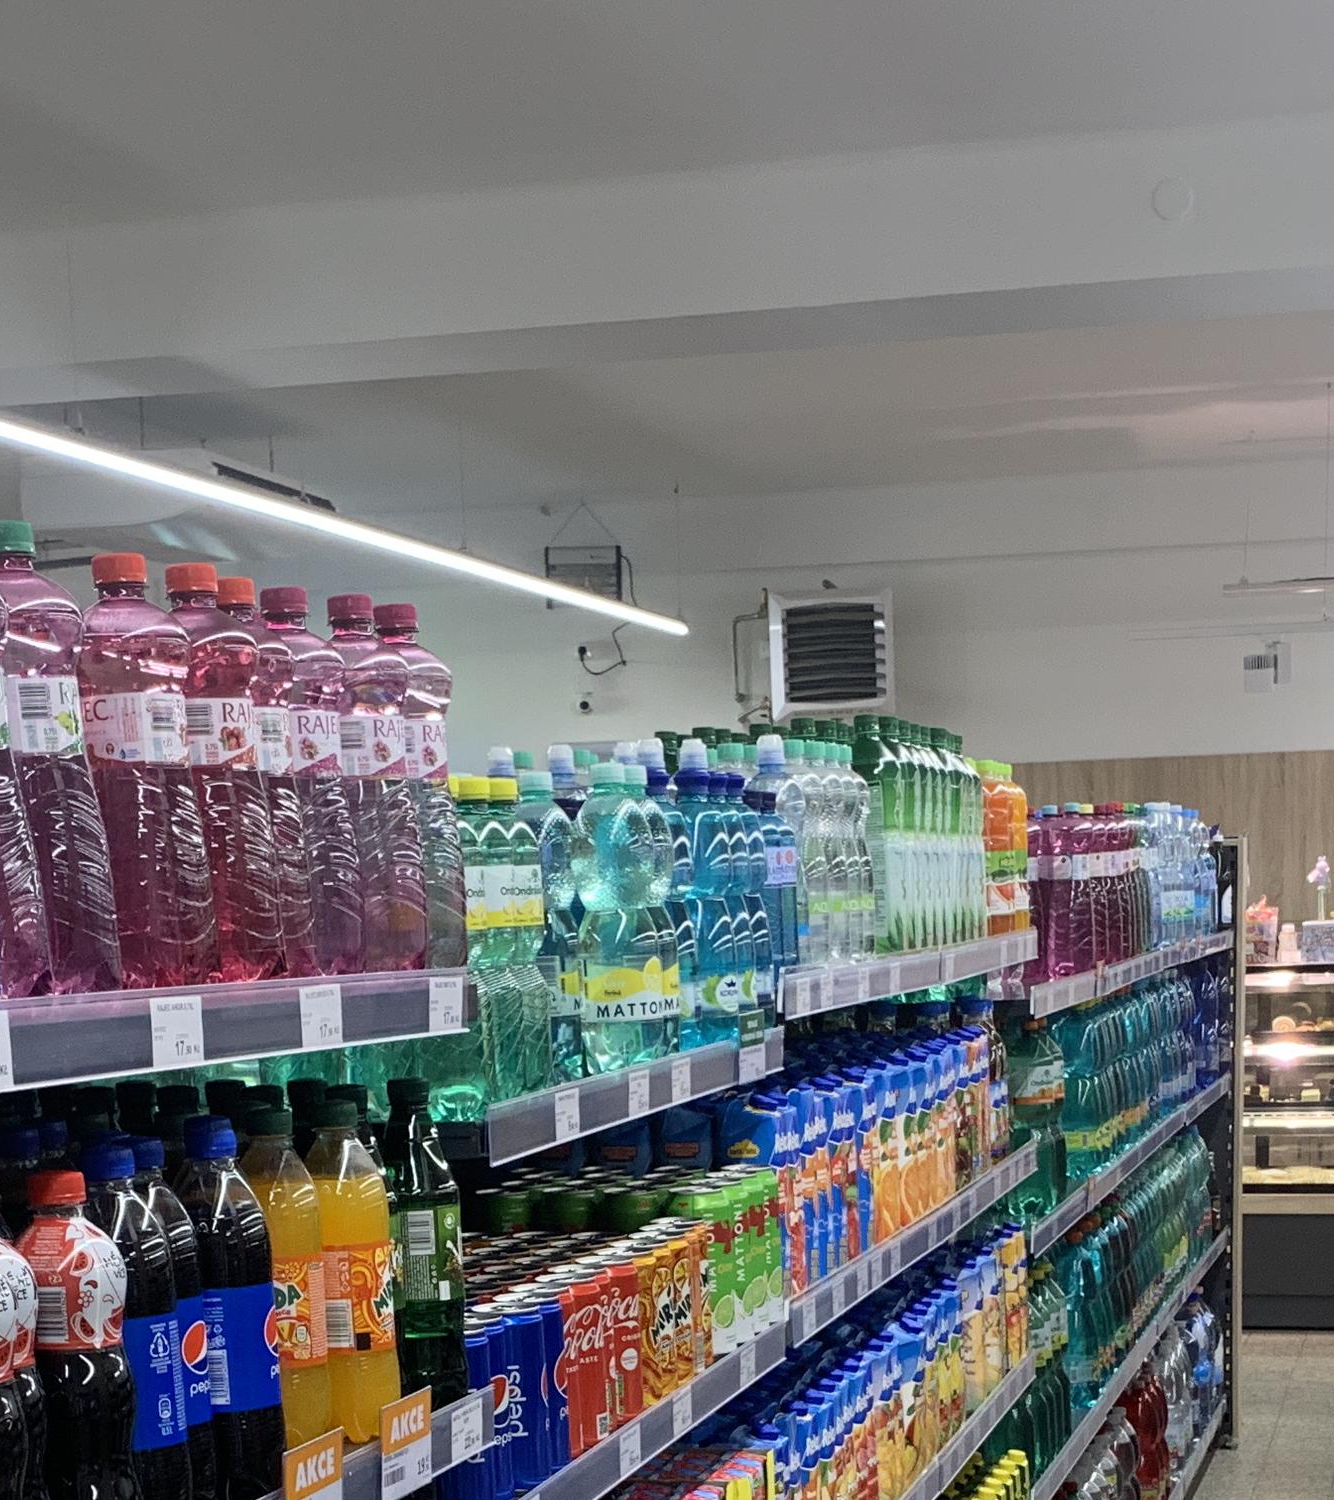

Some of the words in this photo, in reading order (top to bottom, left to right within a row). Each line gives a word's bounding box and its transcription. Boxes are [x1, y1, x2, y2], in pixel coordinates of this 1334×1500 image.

[297, 713, 338, 740] RAJE
[734, 1203, 746, 1282] MATTONI
[391, 1404, 425, 1444] AKCE
[295, 1446, 336, 1493] AKCE
